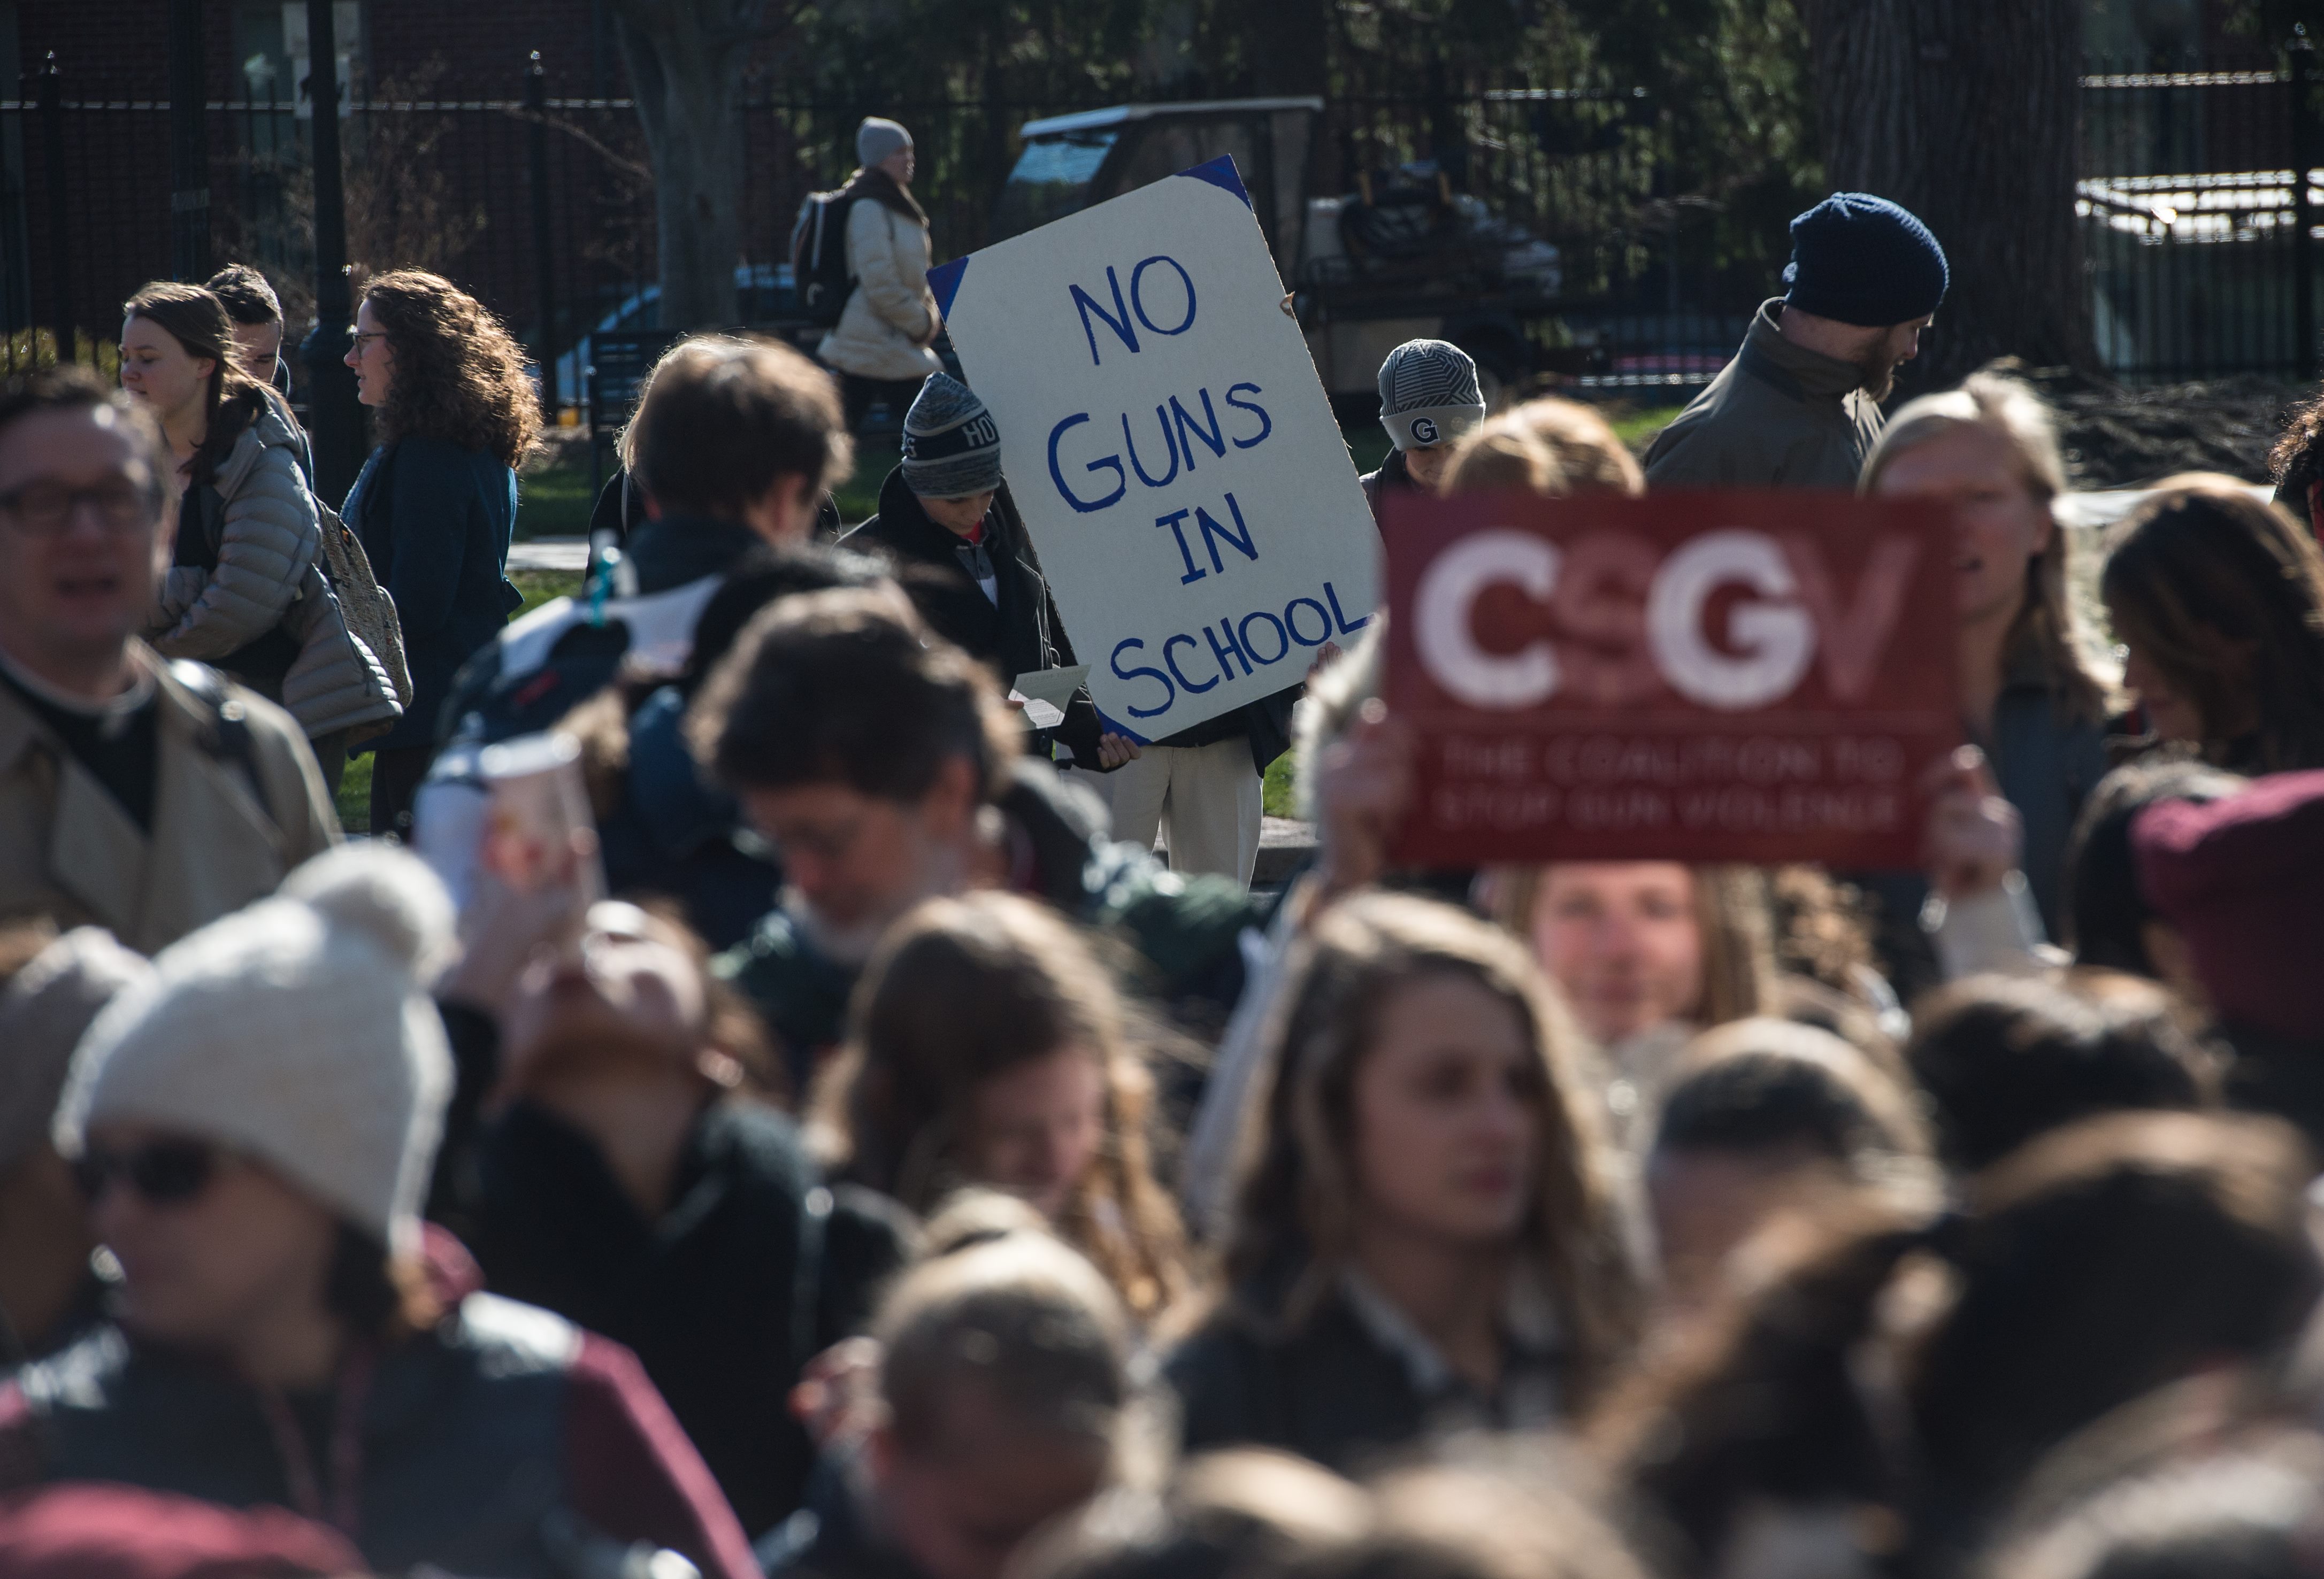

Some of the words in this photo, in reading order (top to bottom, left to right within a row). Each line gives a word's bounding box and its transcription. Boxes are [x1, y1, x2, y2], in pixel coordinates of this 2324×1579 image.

[1069, 255, 1197, 366] NO
[1047, 382, 1272, 514] GUNS
[1409, 417, 1440, 445] G
[1155, 492, 1259, 586] IN
[1110, 582, 1376, 719] SCHOOL
[1412, 527, 1922, 710] CSGV
